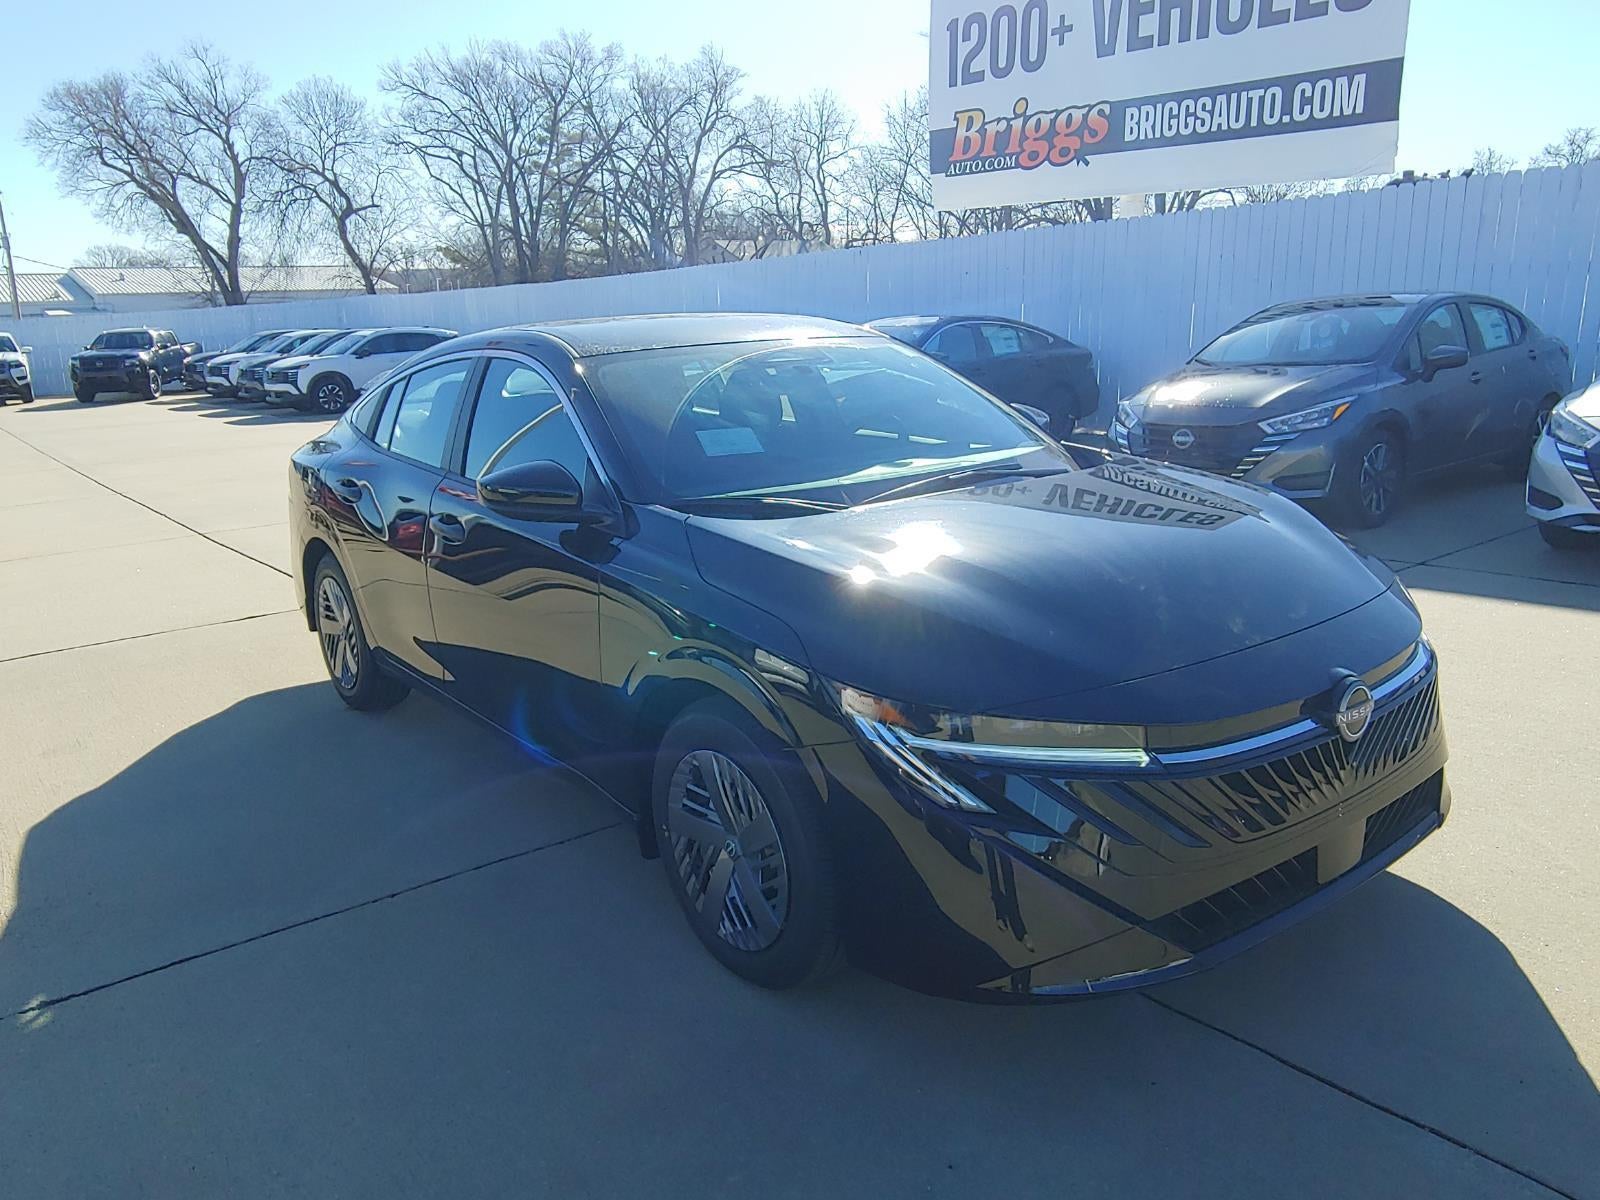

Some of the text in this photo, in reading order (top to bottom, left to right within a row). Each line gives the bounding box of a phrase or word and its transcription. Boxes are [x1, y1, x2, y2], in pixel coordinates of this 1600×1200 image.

[946, 0, 1374, 88] 1200+ VEHI
[950, 98, 1111, 168] Briggs
[1124, 73, 1367, 142] BRIGGSAUTO.COM
[947, 155, 1016, 176] AUTO.COM
[1338, 703, 1371, 723] NISS
